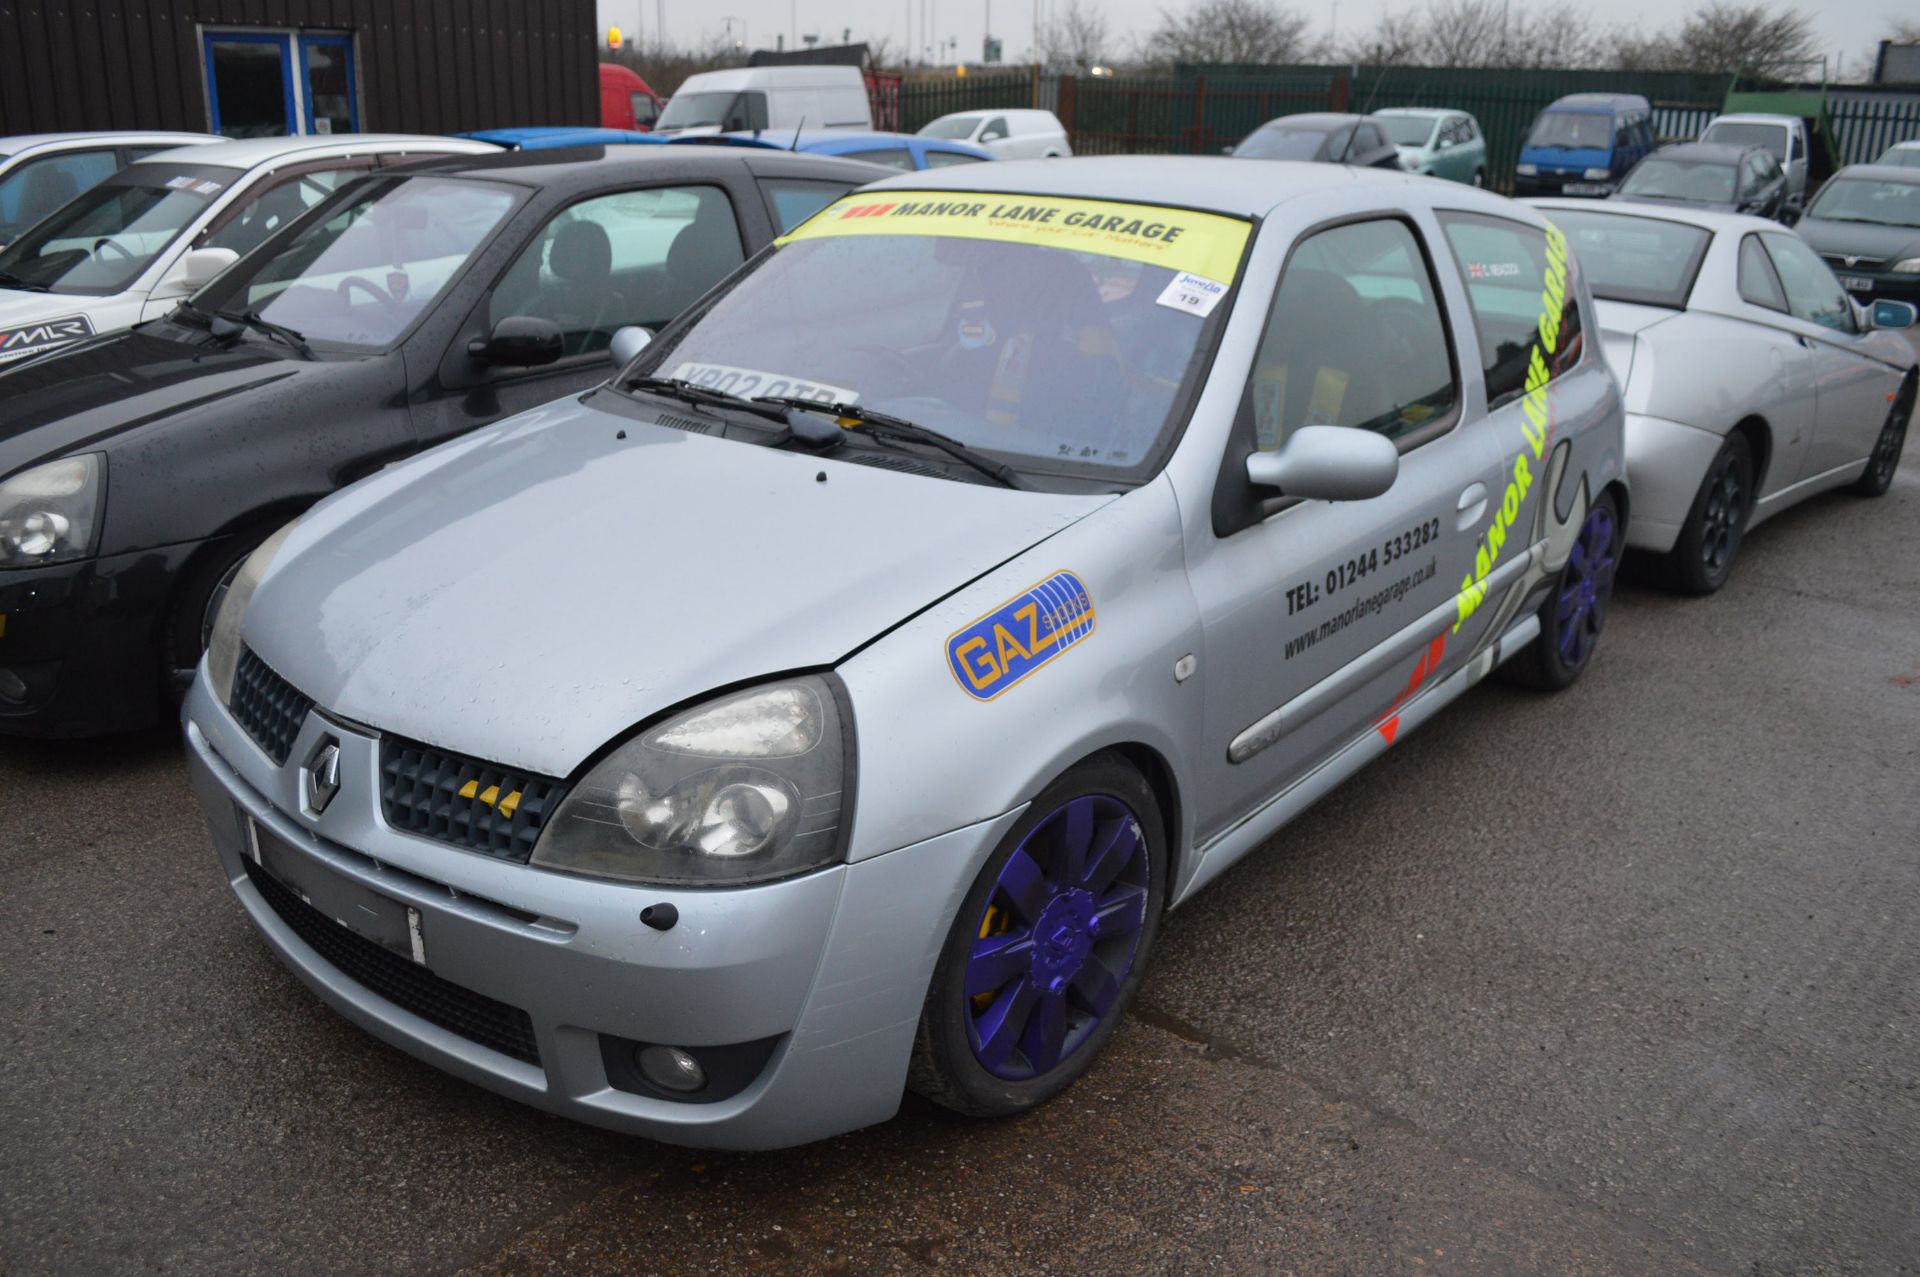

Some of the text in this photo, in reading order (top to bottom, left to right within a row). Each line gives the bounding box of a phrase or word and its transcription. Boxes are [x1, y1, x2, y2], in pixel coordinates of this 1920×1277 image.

[891, 202, 1185, 243] MANOR LANE GARAGE
[1180, 294, 1200, 305] 19
[3, 321, 85, 348] MLR
[1452, 453, 1533, 634] MANOR
[1521, 345, 1550, 460] LANE
[1286, 517, 1440, 616] TEL: 01244 533282
[1042, 592, 1090, 630] SHOCKS
[1285, 555, 1438, 660] www.manorlanegarage.co.uk
[955, 601, 1040, 690] GAZ
